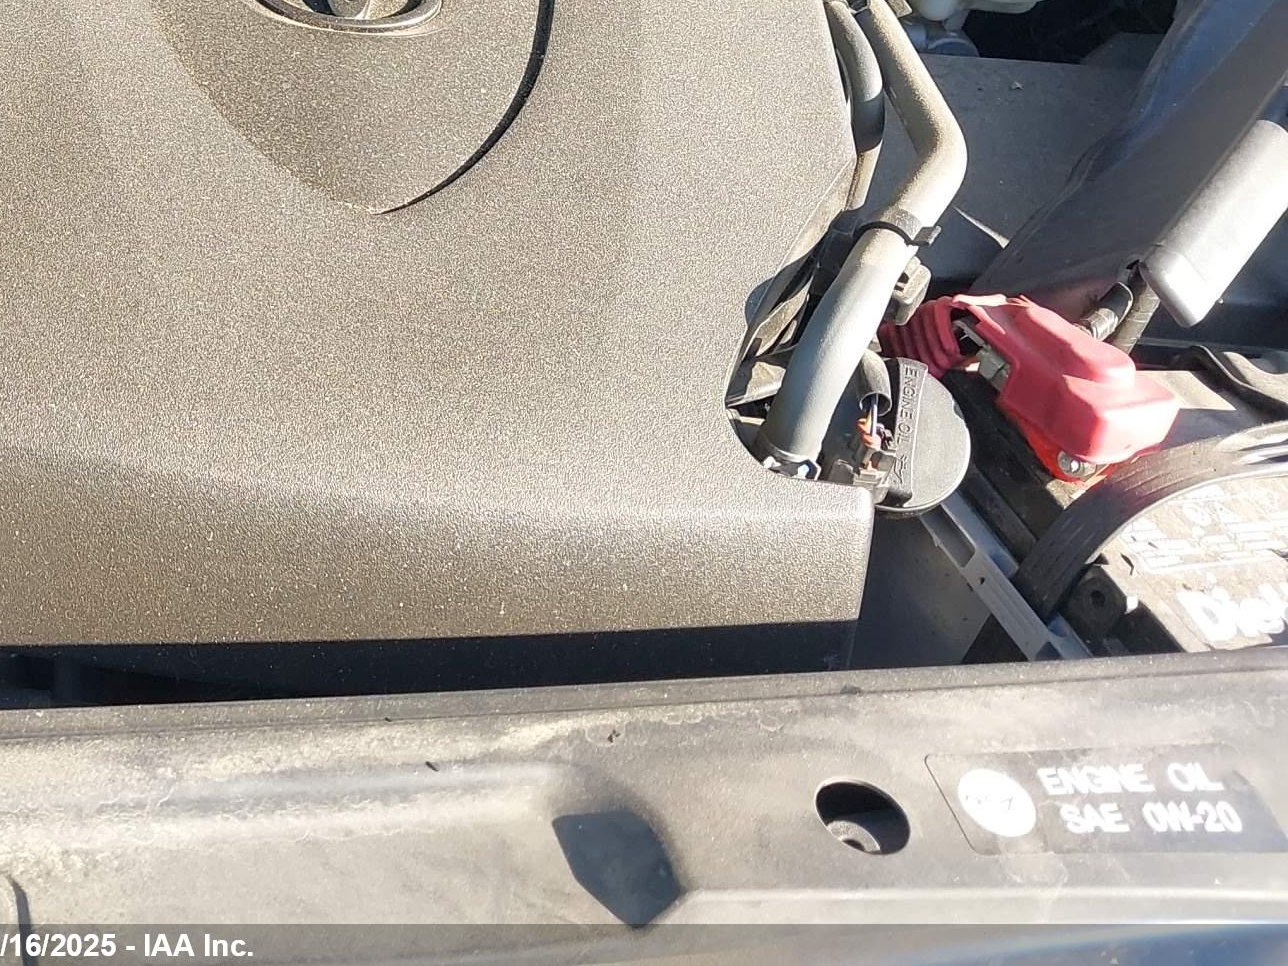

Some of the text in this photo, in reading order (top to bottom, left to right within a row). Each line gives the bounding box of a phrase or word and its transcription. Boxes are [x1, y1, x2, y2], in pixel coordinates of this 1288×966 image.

[896, 366, 918, 445] ENGINE OIL
[1036, 762, 1225, 796] ENGINE OIL
[1059, 800, 1244, 834] SAE 0W-20
